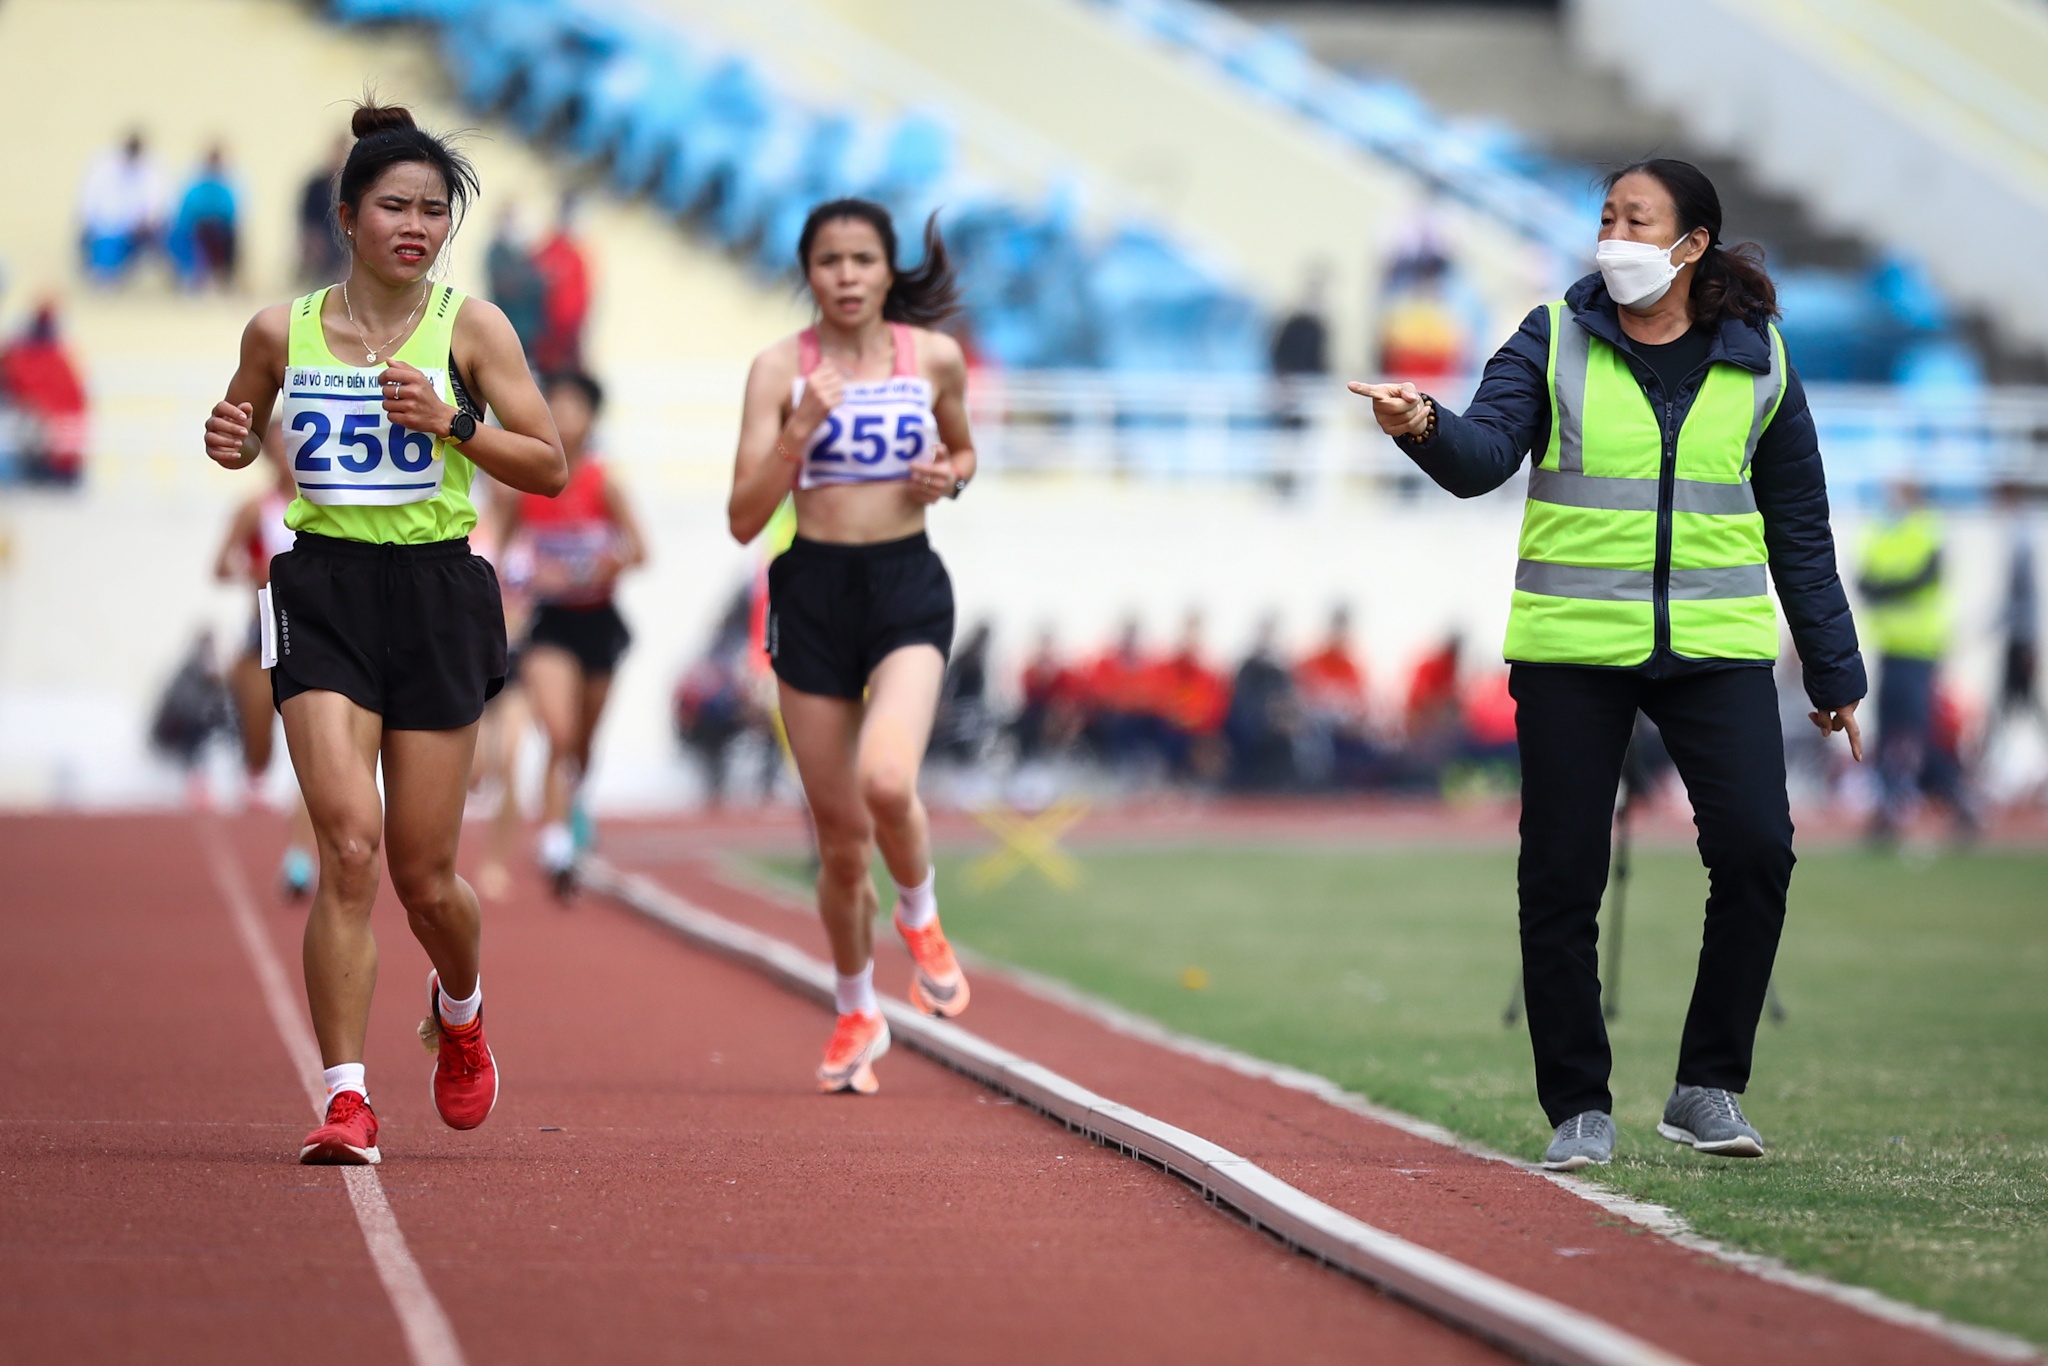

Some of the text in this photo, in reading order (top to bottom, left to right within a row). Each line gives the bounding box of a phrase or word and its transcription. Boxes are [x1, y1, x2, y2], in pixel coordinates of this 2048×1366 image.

[324, 374, 344, 390] ĐỊCH
[291, 411, 434, 473] 256
[809, 414, 924, 465] 255
